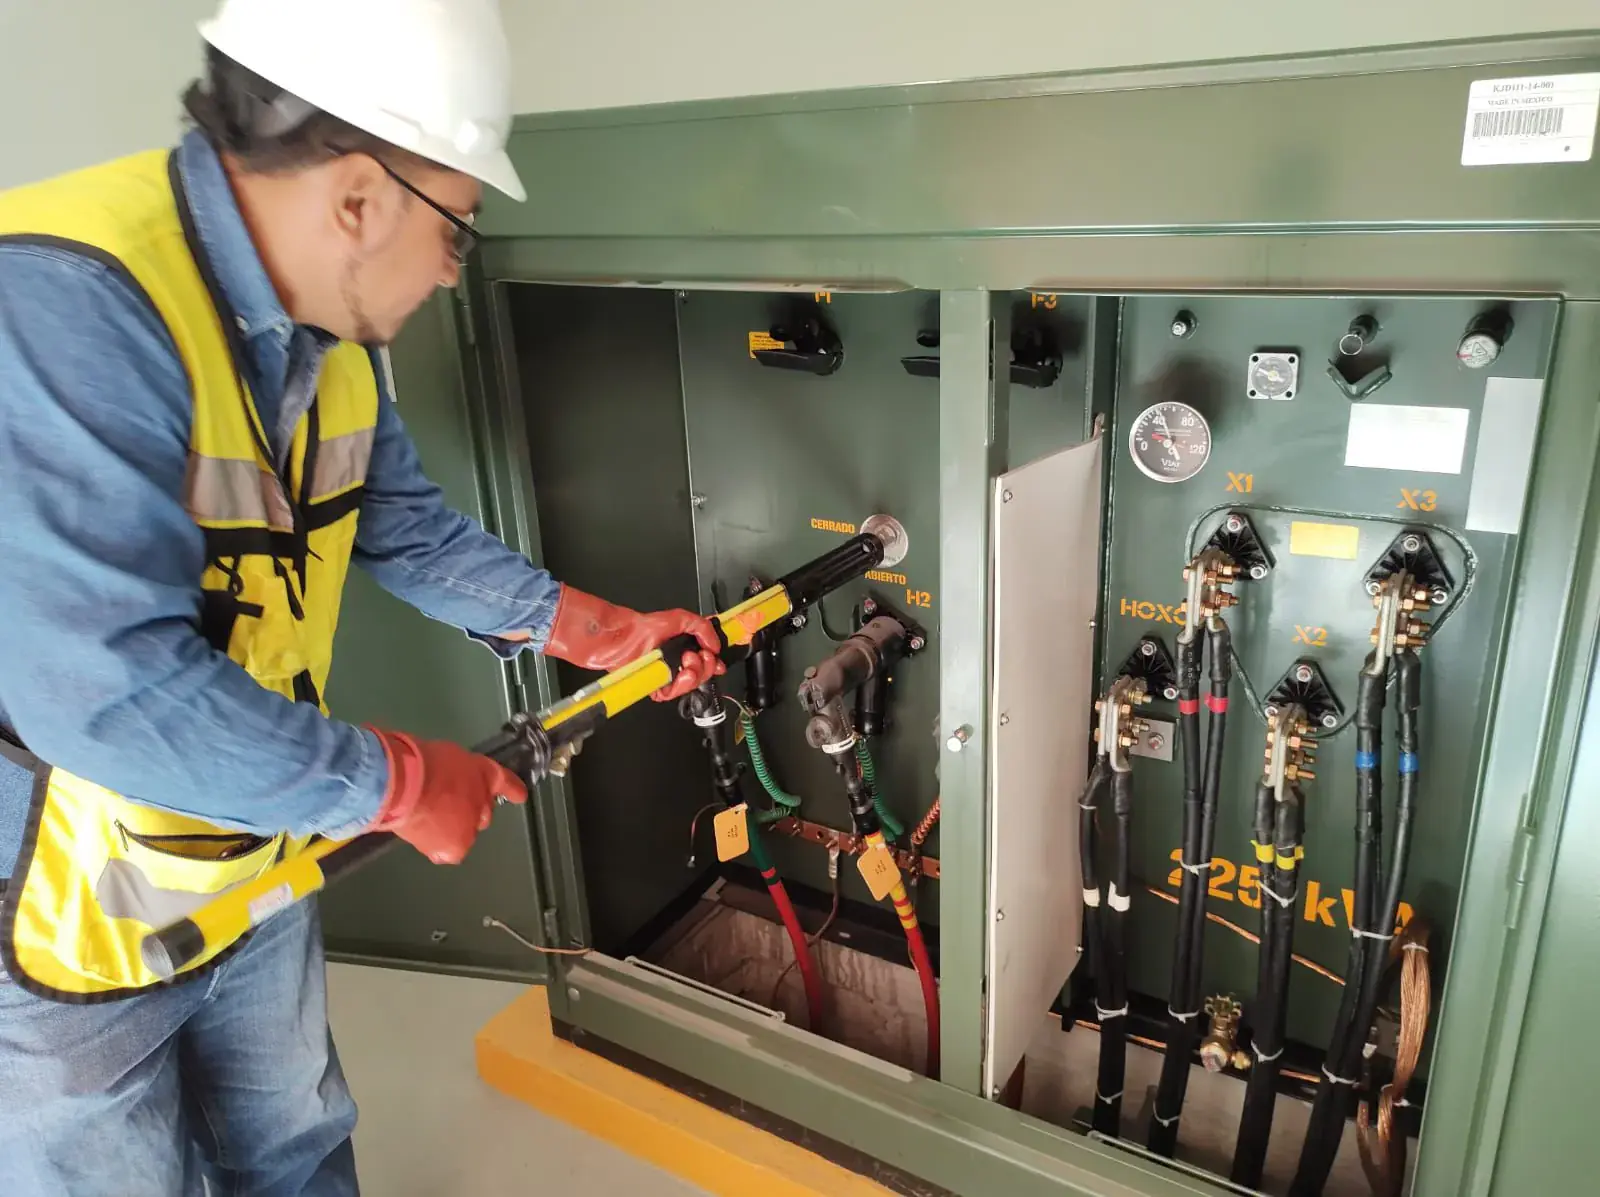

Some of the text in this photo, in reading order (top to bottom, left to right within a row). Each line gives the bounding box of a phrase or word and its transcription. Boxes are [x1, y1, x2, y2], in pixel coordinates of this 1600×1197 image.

[1152, 415, 1166, 426] 40
[1181, 417, 1194, 427] 80
[1141, 441, 1148, 451] 0
[1225, 471, 1254, 493] X1
[1396, 488, 1438, 512] X3
[810, 517, 856, 535] CERRADO
[864, 569, 907, 586] ABIERTO
[906, 587, 932, 609] H2
[1292, 625, 1328, 647] X2
